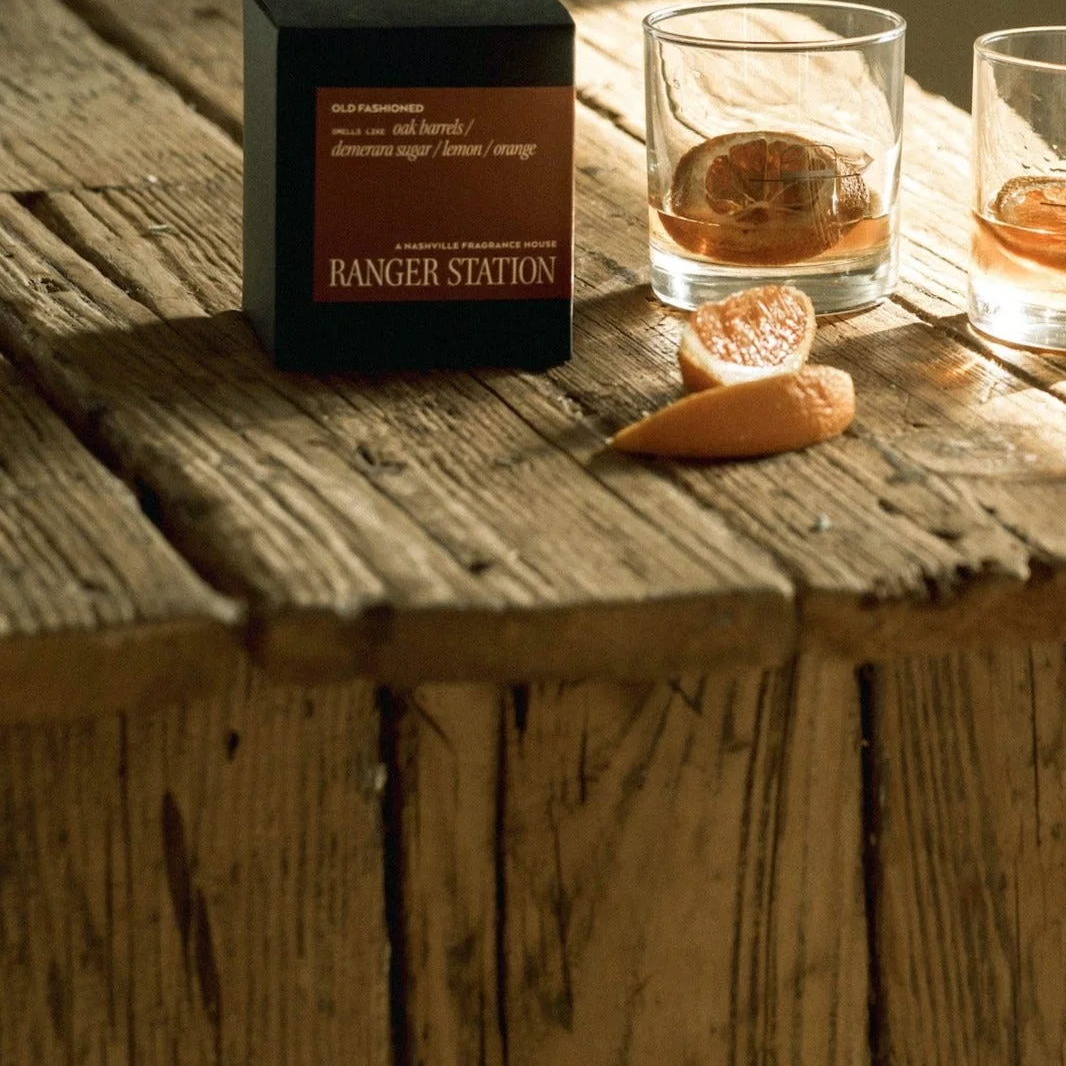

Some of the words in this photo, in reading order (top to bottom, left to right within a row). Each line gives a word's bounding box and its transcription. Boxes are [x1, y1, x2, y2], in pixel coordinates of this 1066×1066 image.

[331, 104, 356, 113] OLD
[358, 103, 424, 113] FASHIONED
[392, 119, 416, 135] oak
[420, 118, 464, 135] barrels
[331, 140, 394, 157] demerara
[396, 145, 431, 161] sugar
[442, 140, 482, 156] lemon
[494, 142, 536, 160] orange
[404, 242, 459, 250] NASHVILLE
[462, 241, 521, 249] FRAGRANCE
[524, 240, 557, 248] HOUSE
[330, 258, 440, 287] RANGER
[447, 256, 556, 285] STATION
